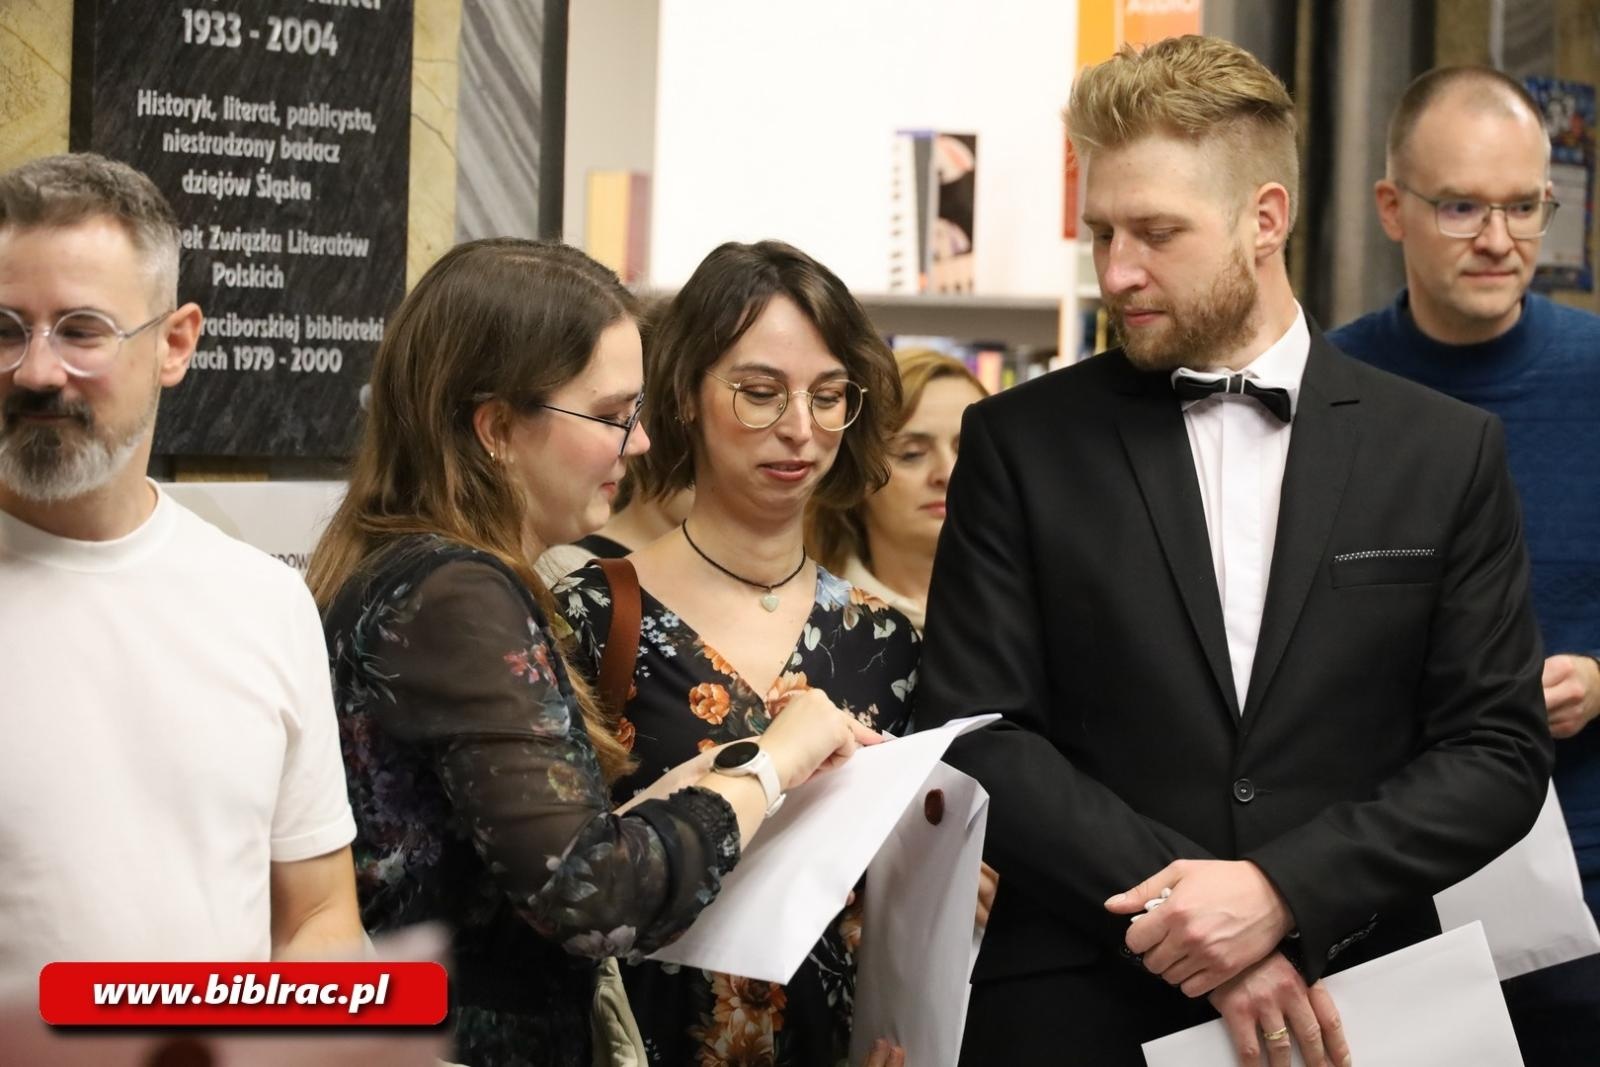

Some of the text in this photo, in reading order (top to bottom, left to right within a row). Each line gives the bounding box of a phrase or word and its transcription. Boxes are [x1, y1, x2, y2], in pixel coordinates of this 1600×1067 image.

[182, 8, 242, 48] 1933
[266, 16, 338, 56] 2004
[137, 90, 377, 135] Historyk, literat, publicysta,
[162, 128, 341, 164] niestrudzony badacz
[182, 168, 312, 204] dziejów Śląska
[179, 224, 370, 258] ek Związku Literatów
[212, 262, 285, 289] Polskich
[200, 312, 385, 344] raciborskiej biblioteki
[233, 346, 275, 371] 1979
[290, 347, 343, 373] 2000
